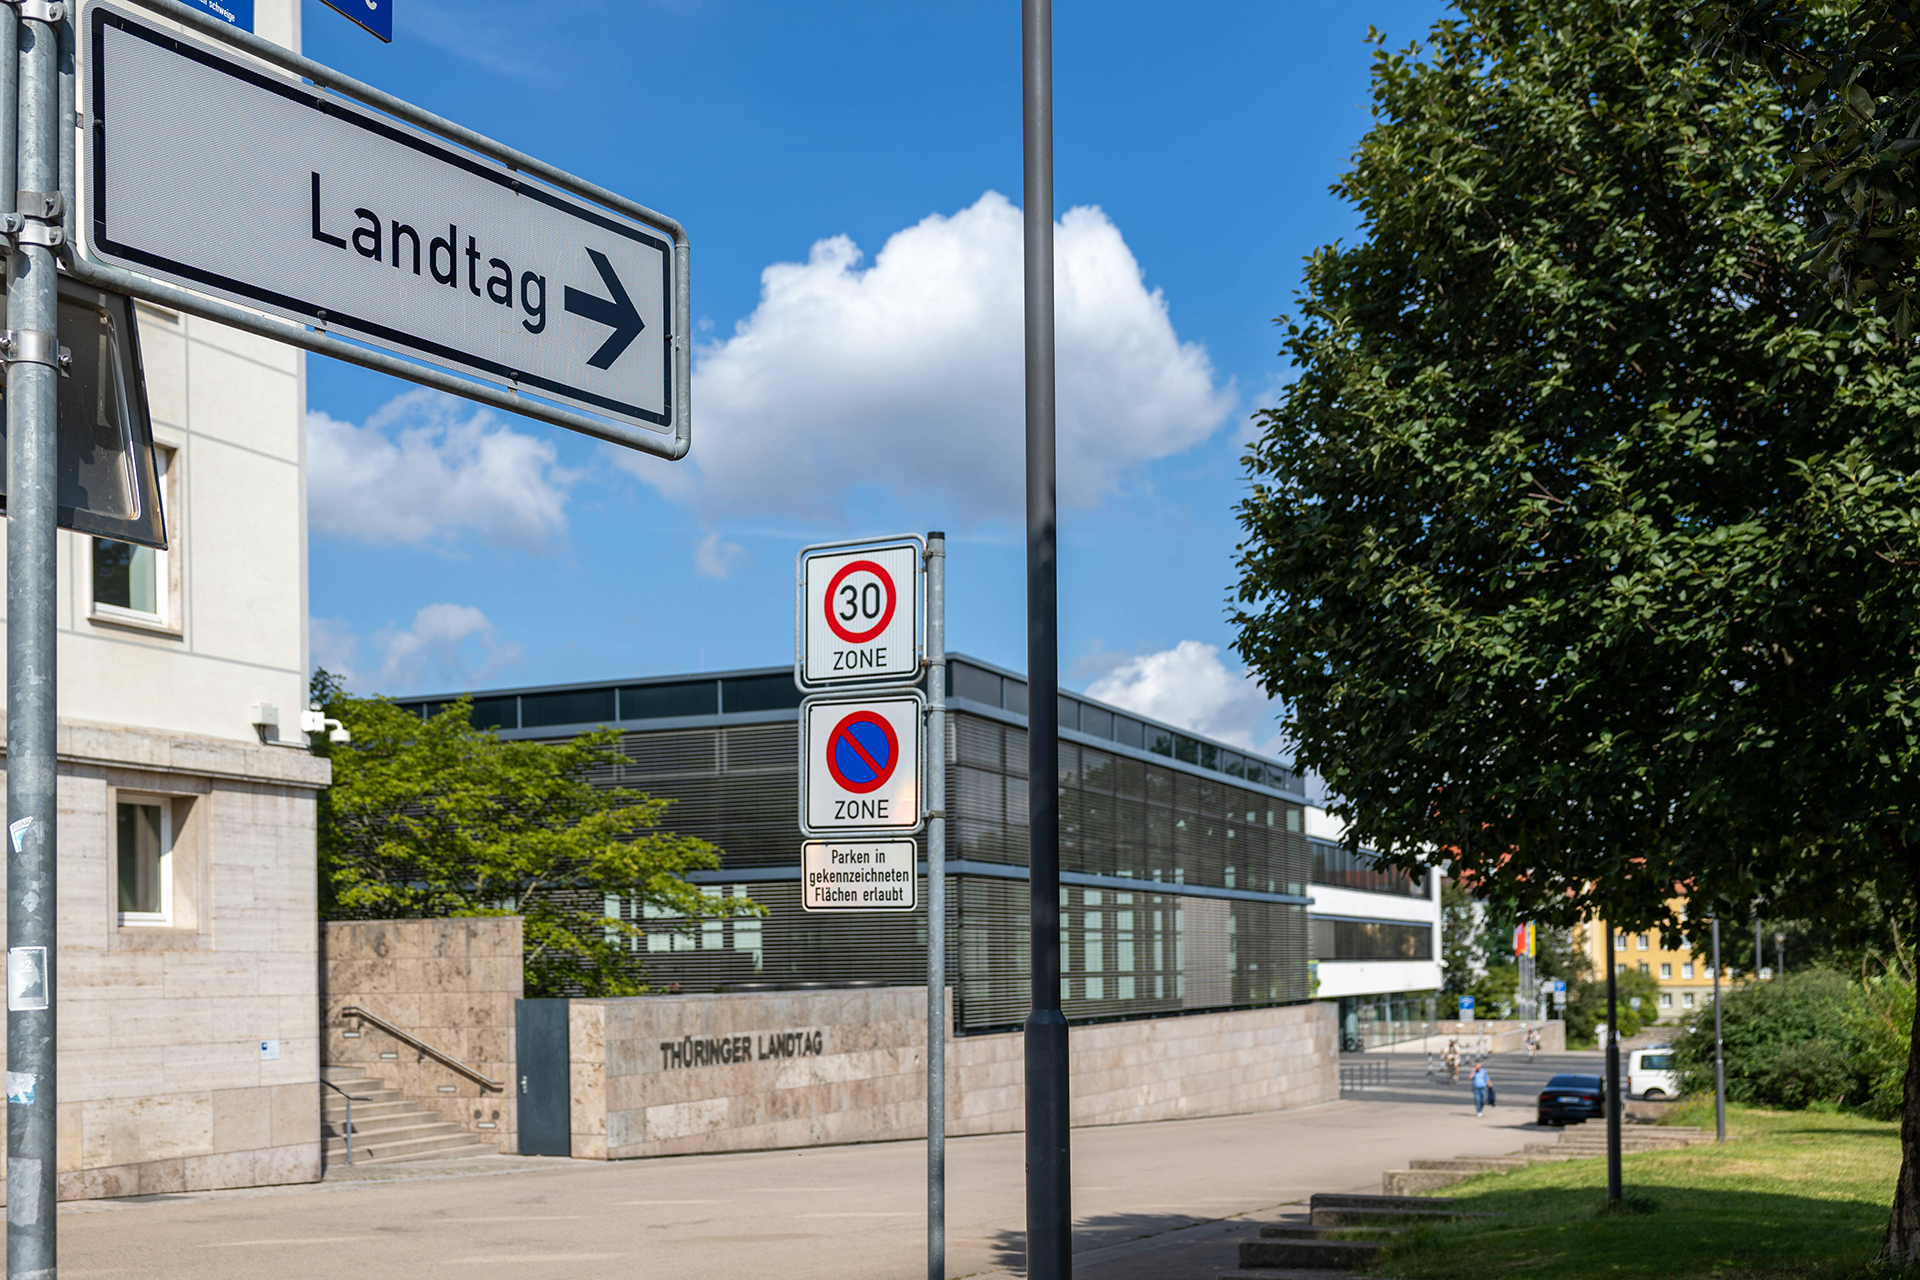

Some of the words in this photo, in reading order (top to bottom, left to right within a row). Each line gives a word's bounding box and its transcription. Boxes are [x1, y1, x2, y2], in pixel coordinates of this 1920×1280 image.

[208, 0, 236, 23] schweige
[311, 171, 546, 334] Landtag
[839, 582, 880, 622] 30
[833, 647, 887, 671] ZONE
[834, 798, 889, 820] ZONE
[831, 849, 870, 864] Parken
[875, 848, 886, 864] in
[809, 867, 909, 887] gekennzeichneten
[815, 886, 858, 902] Flächen
[863, 886, 904, 902] erlaubt
[660, 1035, 752, 1070] THÜRINGER
[758, 1030, 823, 1060] LANDTAG
